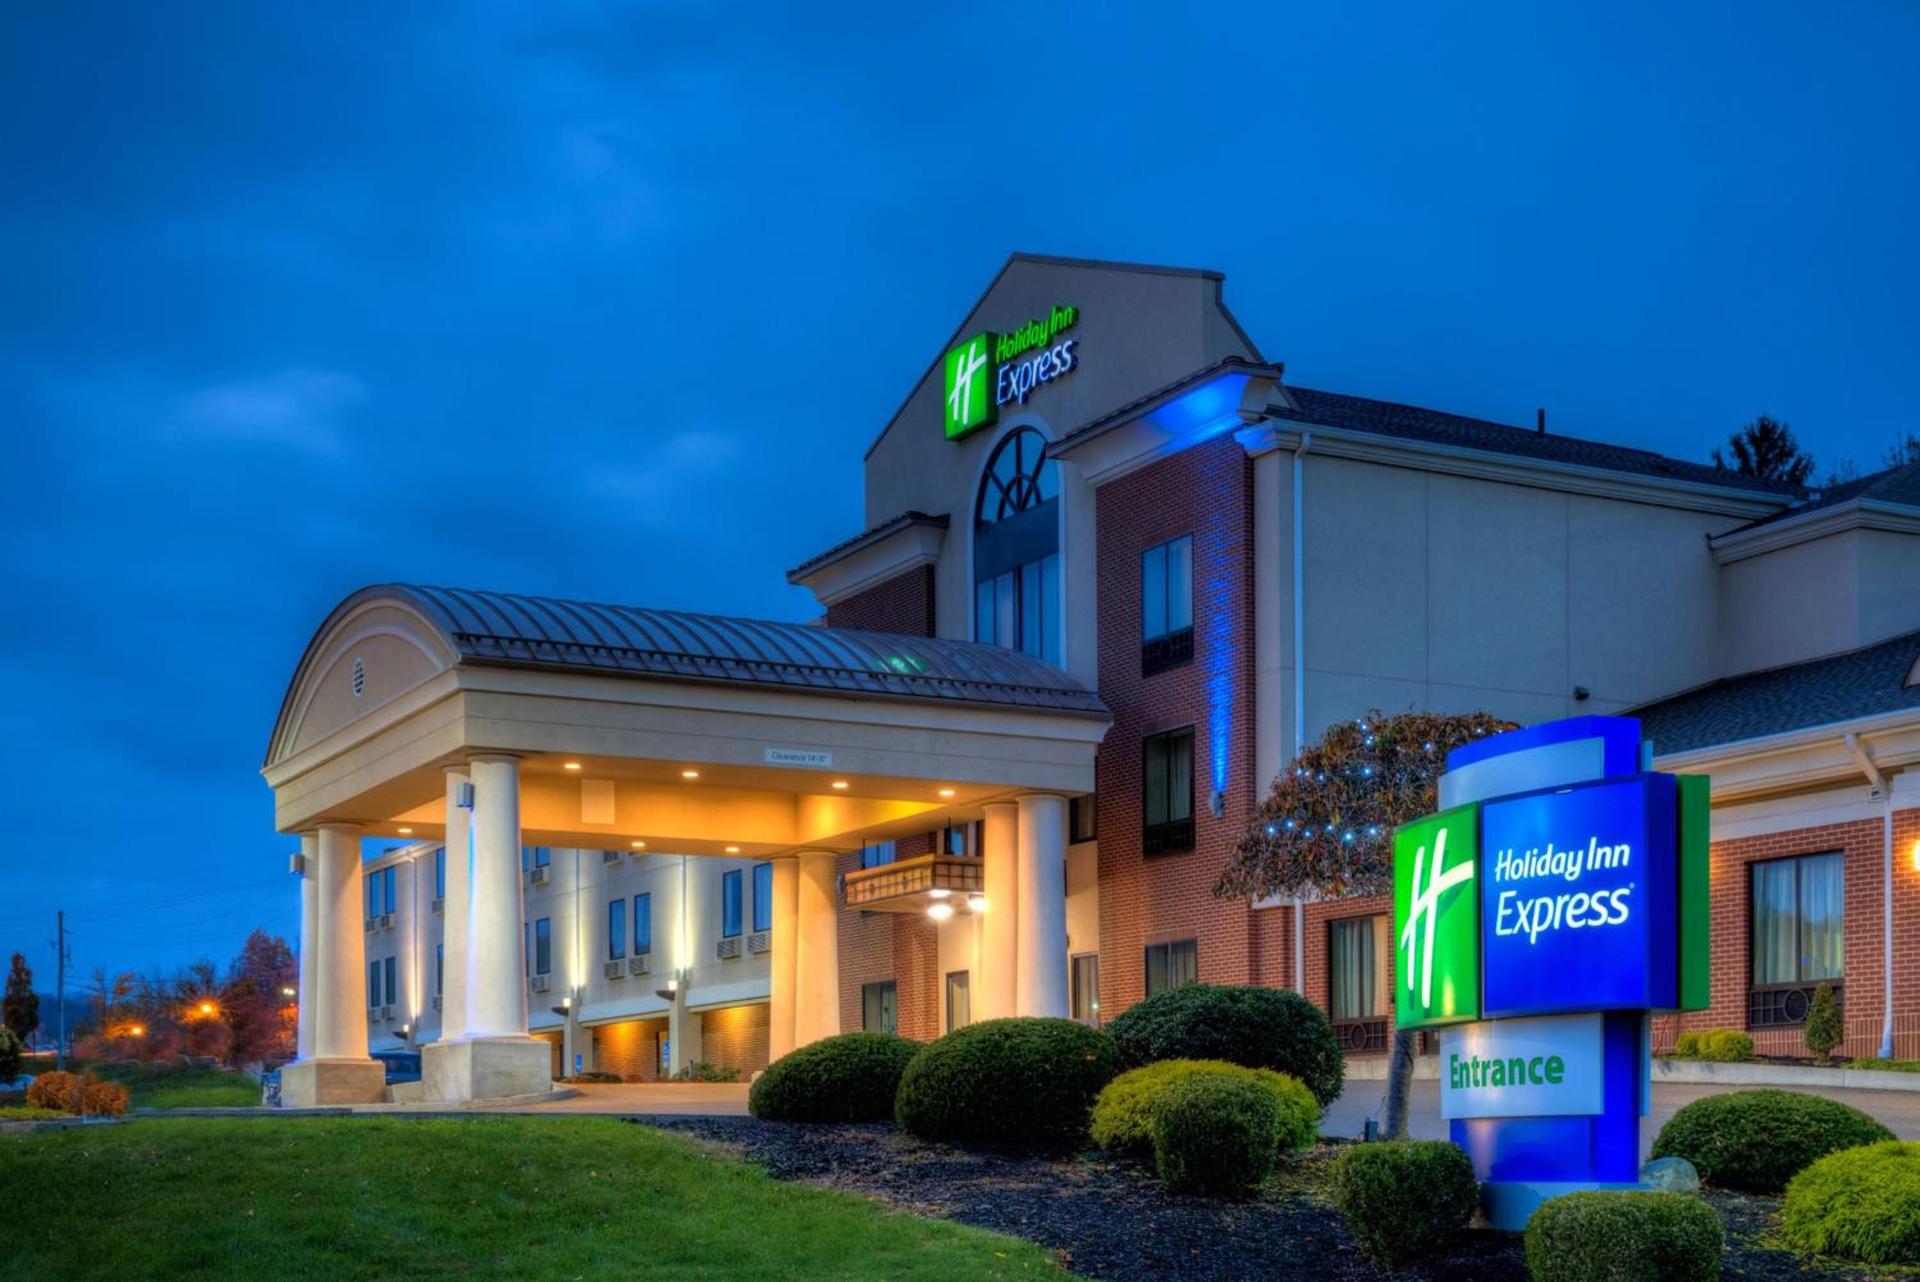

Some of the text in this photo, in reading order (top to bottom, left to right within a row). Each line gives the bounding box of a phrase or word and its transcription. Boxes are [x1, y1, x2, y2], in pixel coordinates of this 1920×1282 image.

[996, 305, 1075, 364] Holiday Inn
[996, 340, 1074, 406] Express
[1494, 836, 1631, 883] Holiday Inn
[1495, 887, 1632, 946] Express
[1450, 1053, 1566, 1090] Entrance
